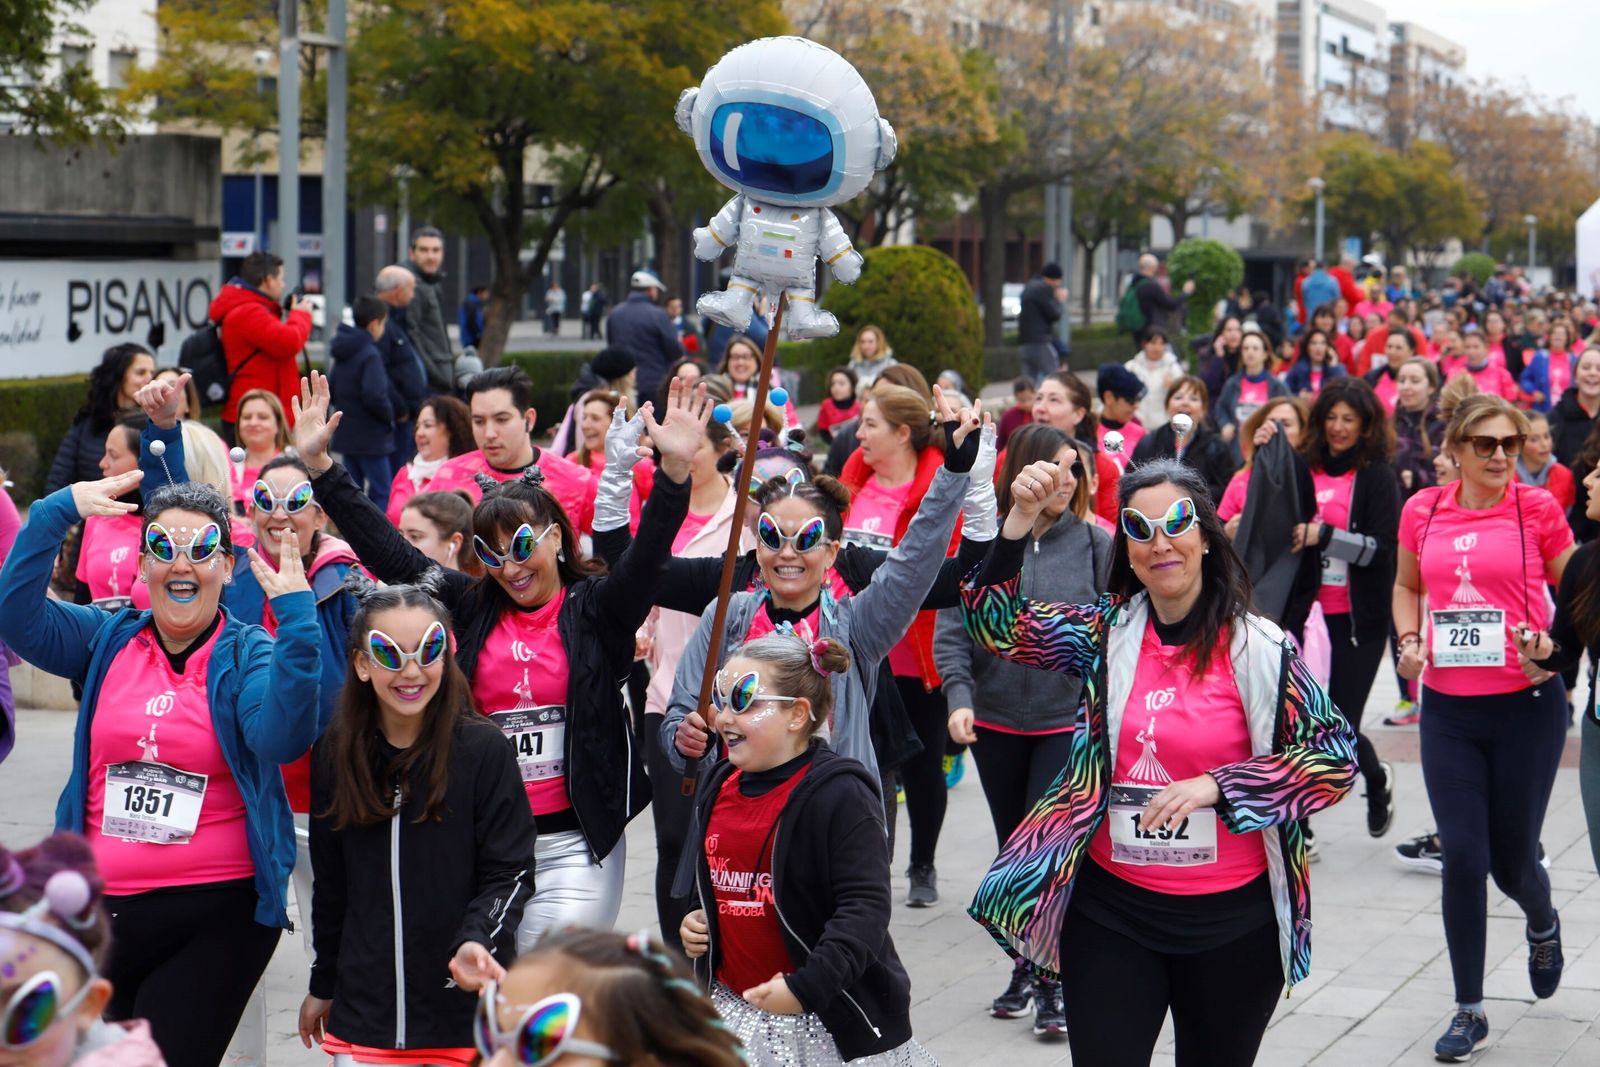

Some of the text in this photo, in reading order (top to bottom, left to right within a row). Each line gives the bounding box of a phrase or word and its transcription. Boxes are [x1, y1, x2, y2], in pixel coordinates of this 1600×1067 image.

[68, 278, 212, 336] PISANO
[1450, 628, 1480, 646] 226
[124, 785, 174, 817] 1351
[710, 868, 773, 888] RUNNING
